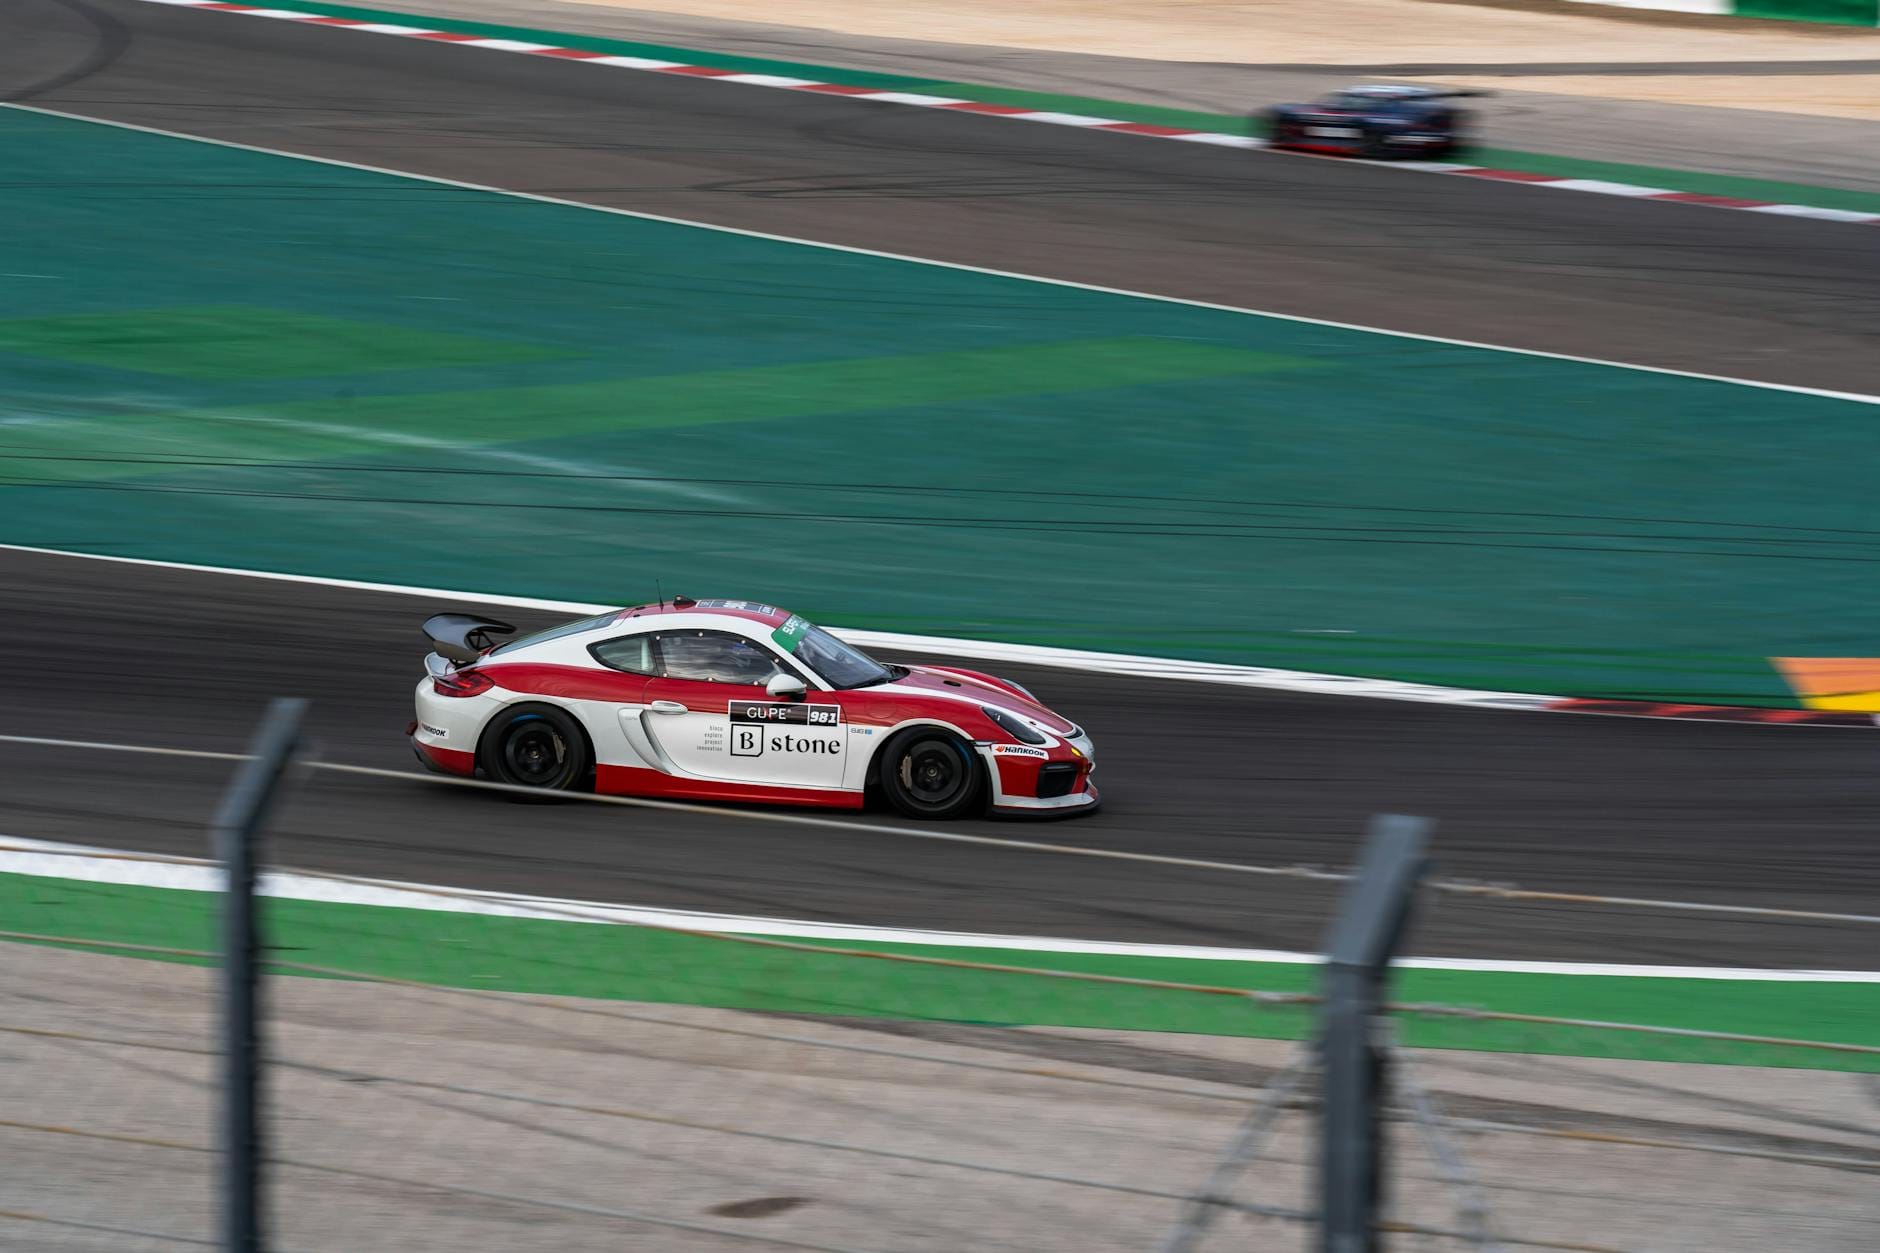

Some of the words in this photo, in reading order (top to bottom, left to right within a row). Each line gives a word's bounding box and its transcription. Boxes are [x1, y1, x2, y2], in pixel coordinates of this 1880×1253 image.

[809, 711, 838, 724] 981
[740, 731, 754, 750] B
[770, 734, 841, 755] stone
